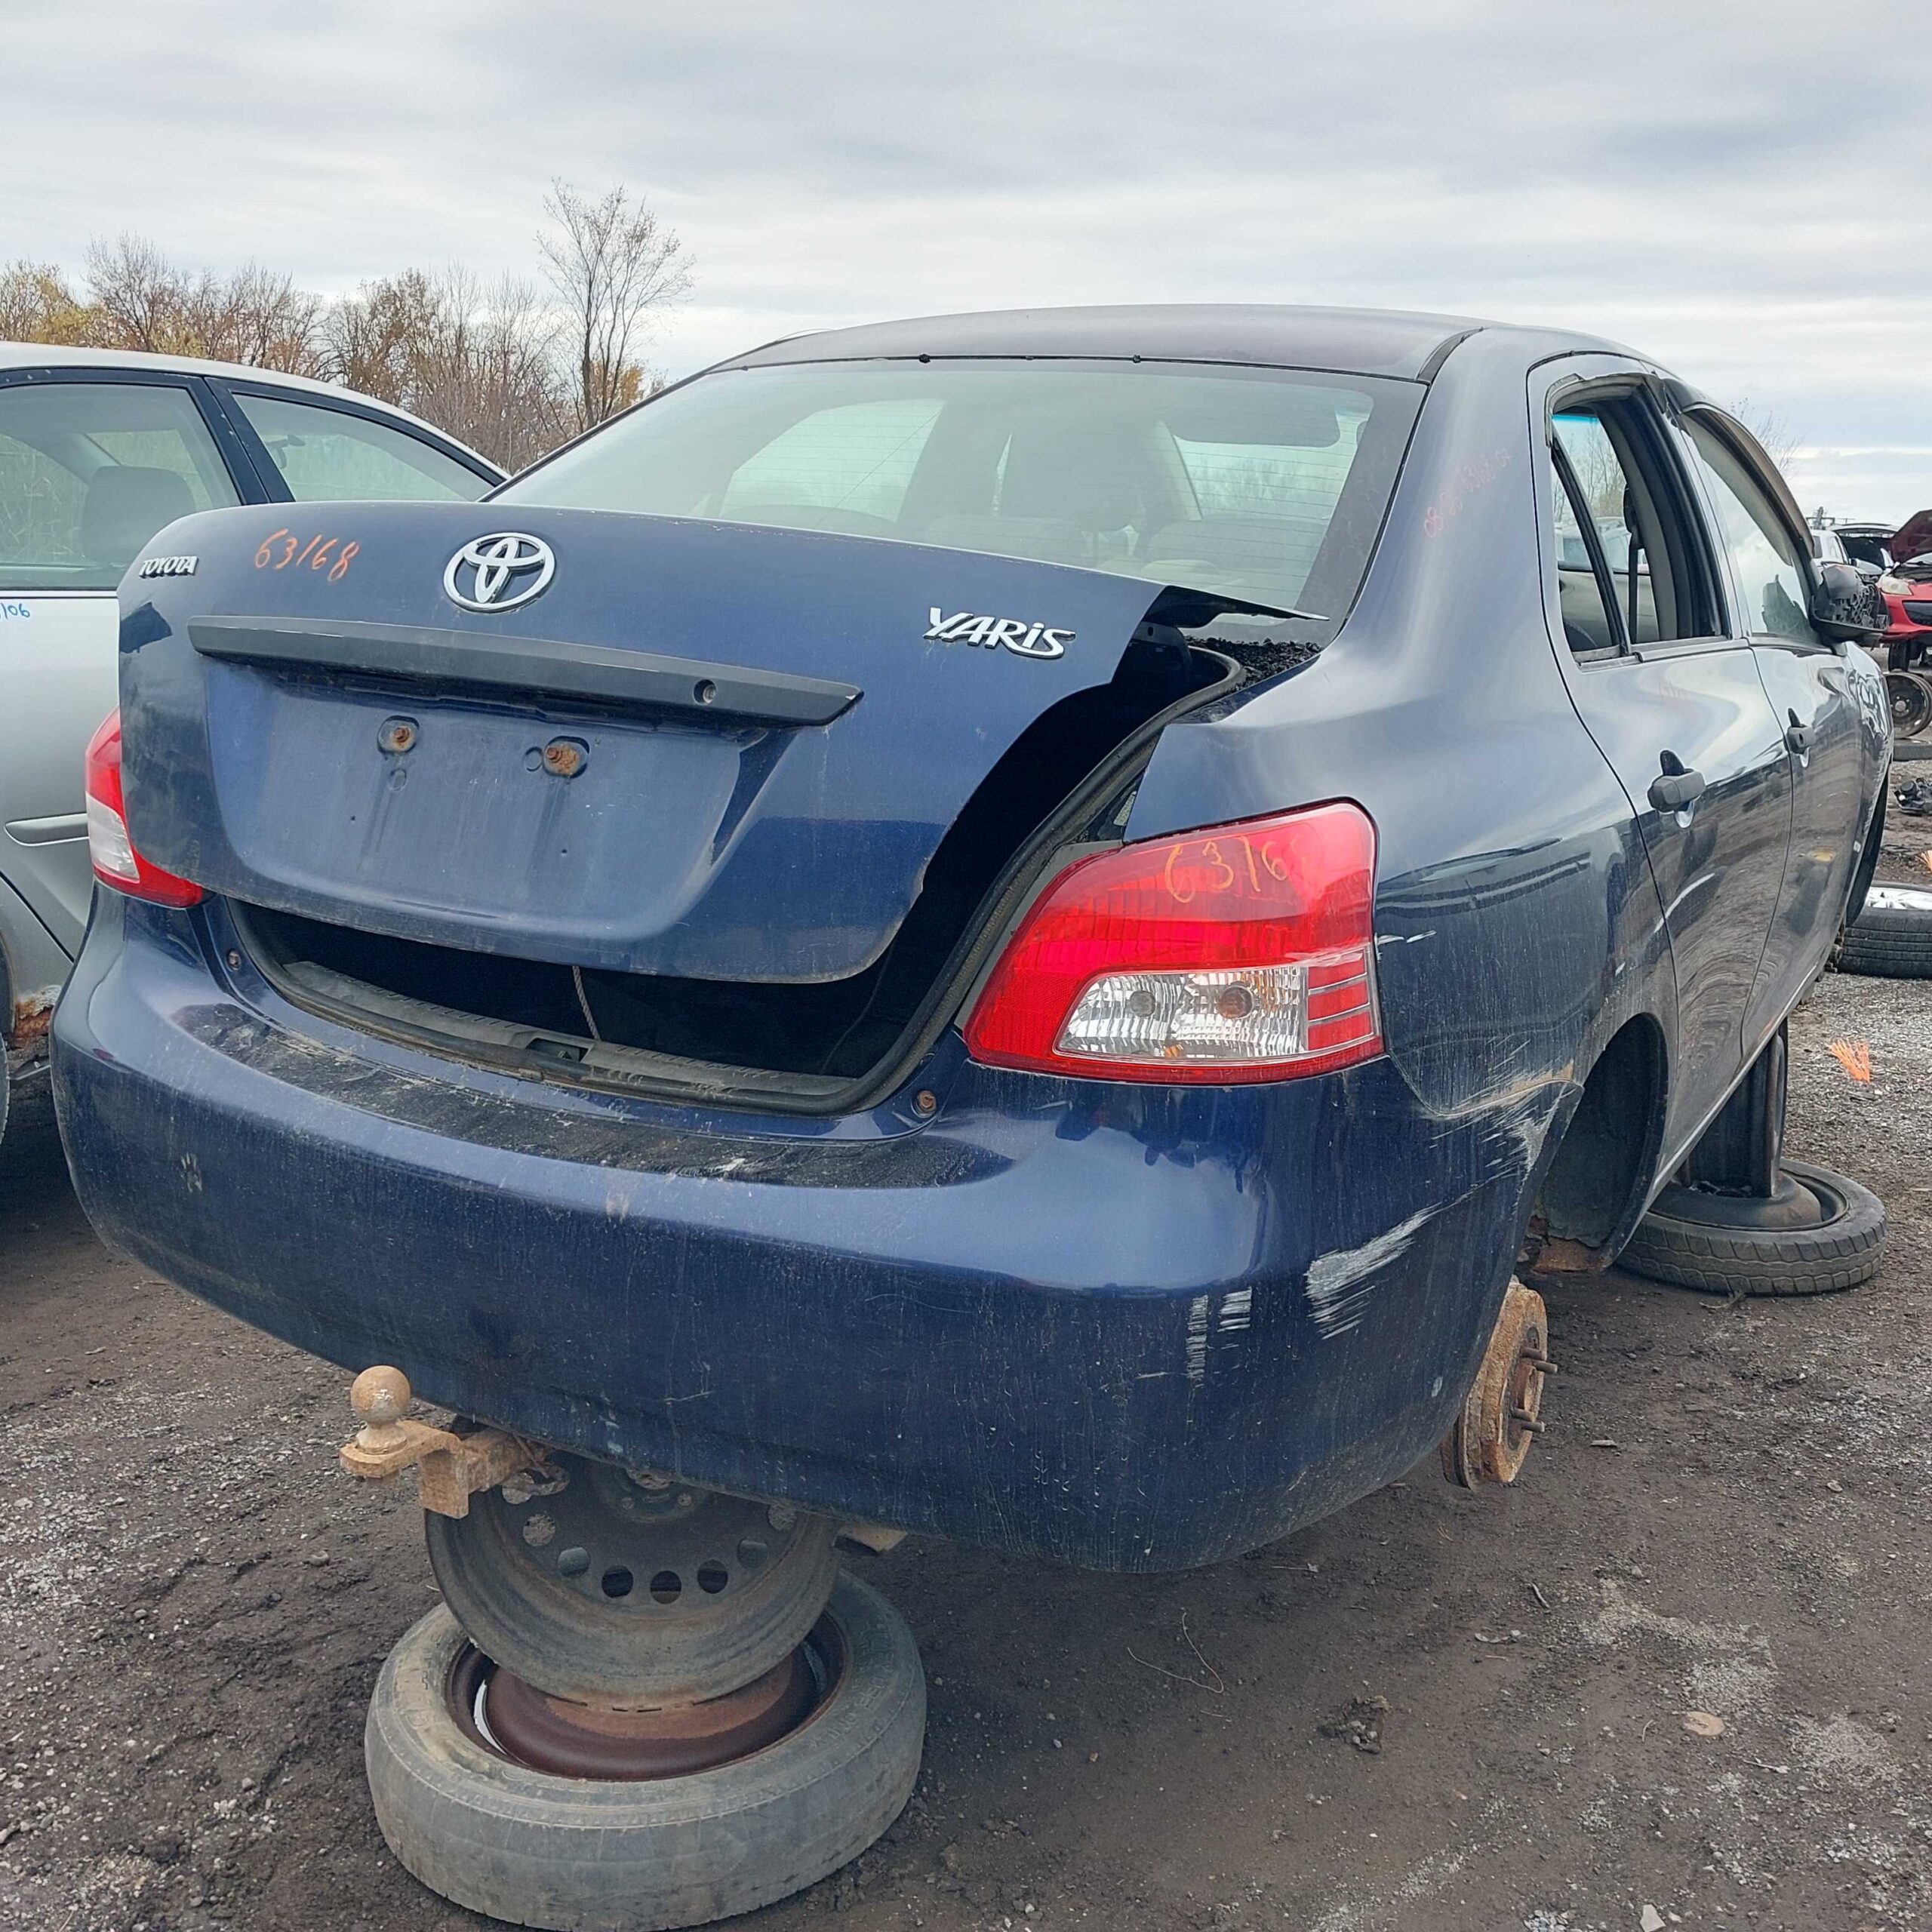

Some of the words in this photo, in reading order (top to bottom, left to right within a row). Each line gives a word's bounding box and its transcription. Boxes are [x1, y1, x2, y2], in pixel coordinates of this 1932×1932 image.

[139, 555, 199, 579] TOYOTA
[254, 528, 360, 582] 63168
[0, 602, 31, 620] 106
